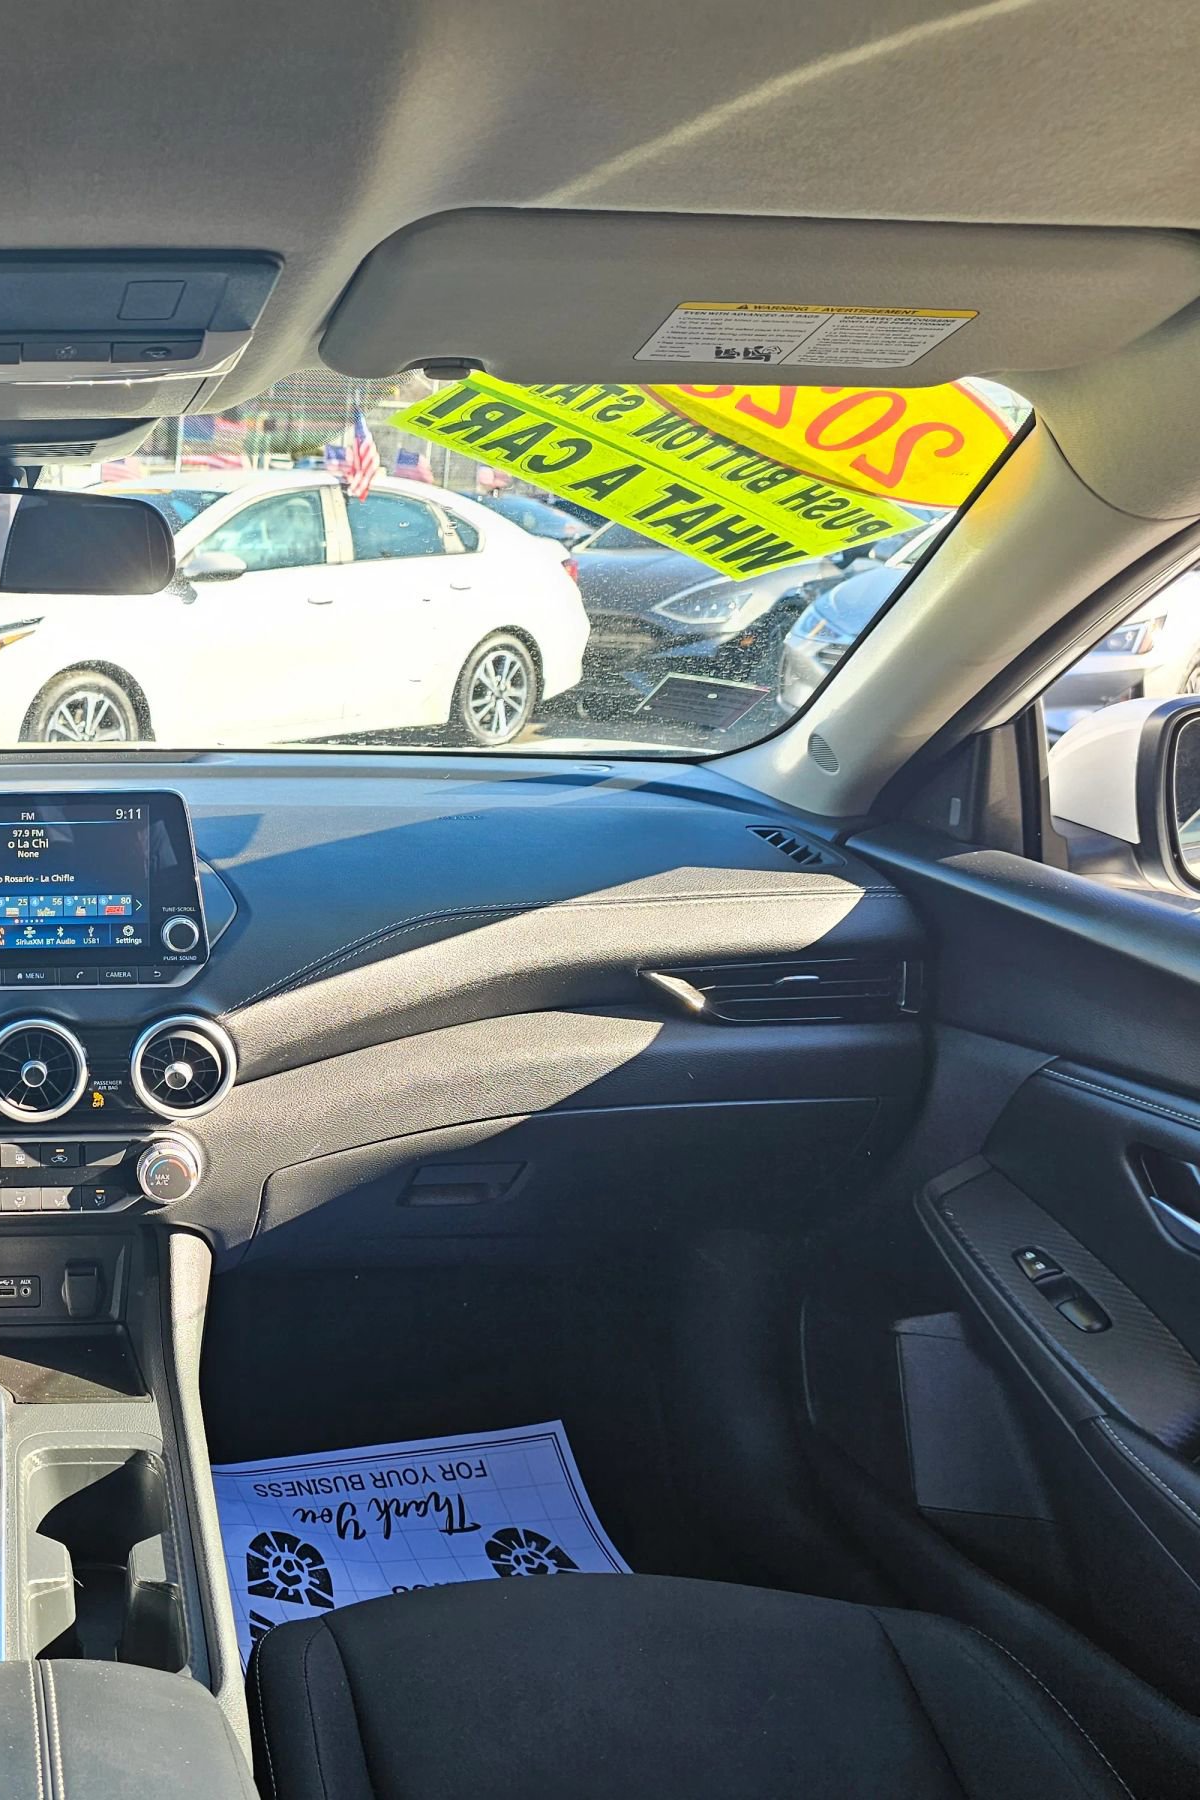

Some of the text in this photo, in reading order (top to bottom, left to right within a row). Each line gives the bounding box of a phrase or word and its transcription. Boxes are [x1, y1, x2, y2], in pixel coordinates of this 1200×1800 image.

[752, 304, 809, 312] WARNING
[820, 307, 919, 316] AVERTISSEMENT
[21, 808, 142, 821] FM 9:11
[12, 829, 44, 838] 97.9 FM
[17, 839, 29, 849] La
[31, 838, 49, 849] Chi
[17, 850, 39, 858] None
[4, 875, 34, 883] Rosario
[40, 874, 49, 882] La
[82, 897, 97, 905] 114
[116, 937, 142, 945] Settings
[155, 1179, 169, 1187] A/C
[253, 1459, 488, 1498] FOR YOUR BUSINESS
[292, 1491, 482, 1540] Thank You
